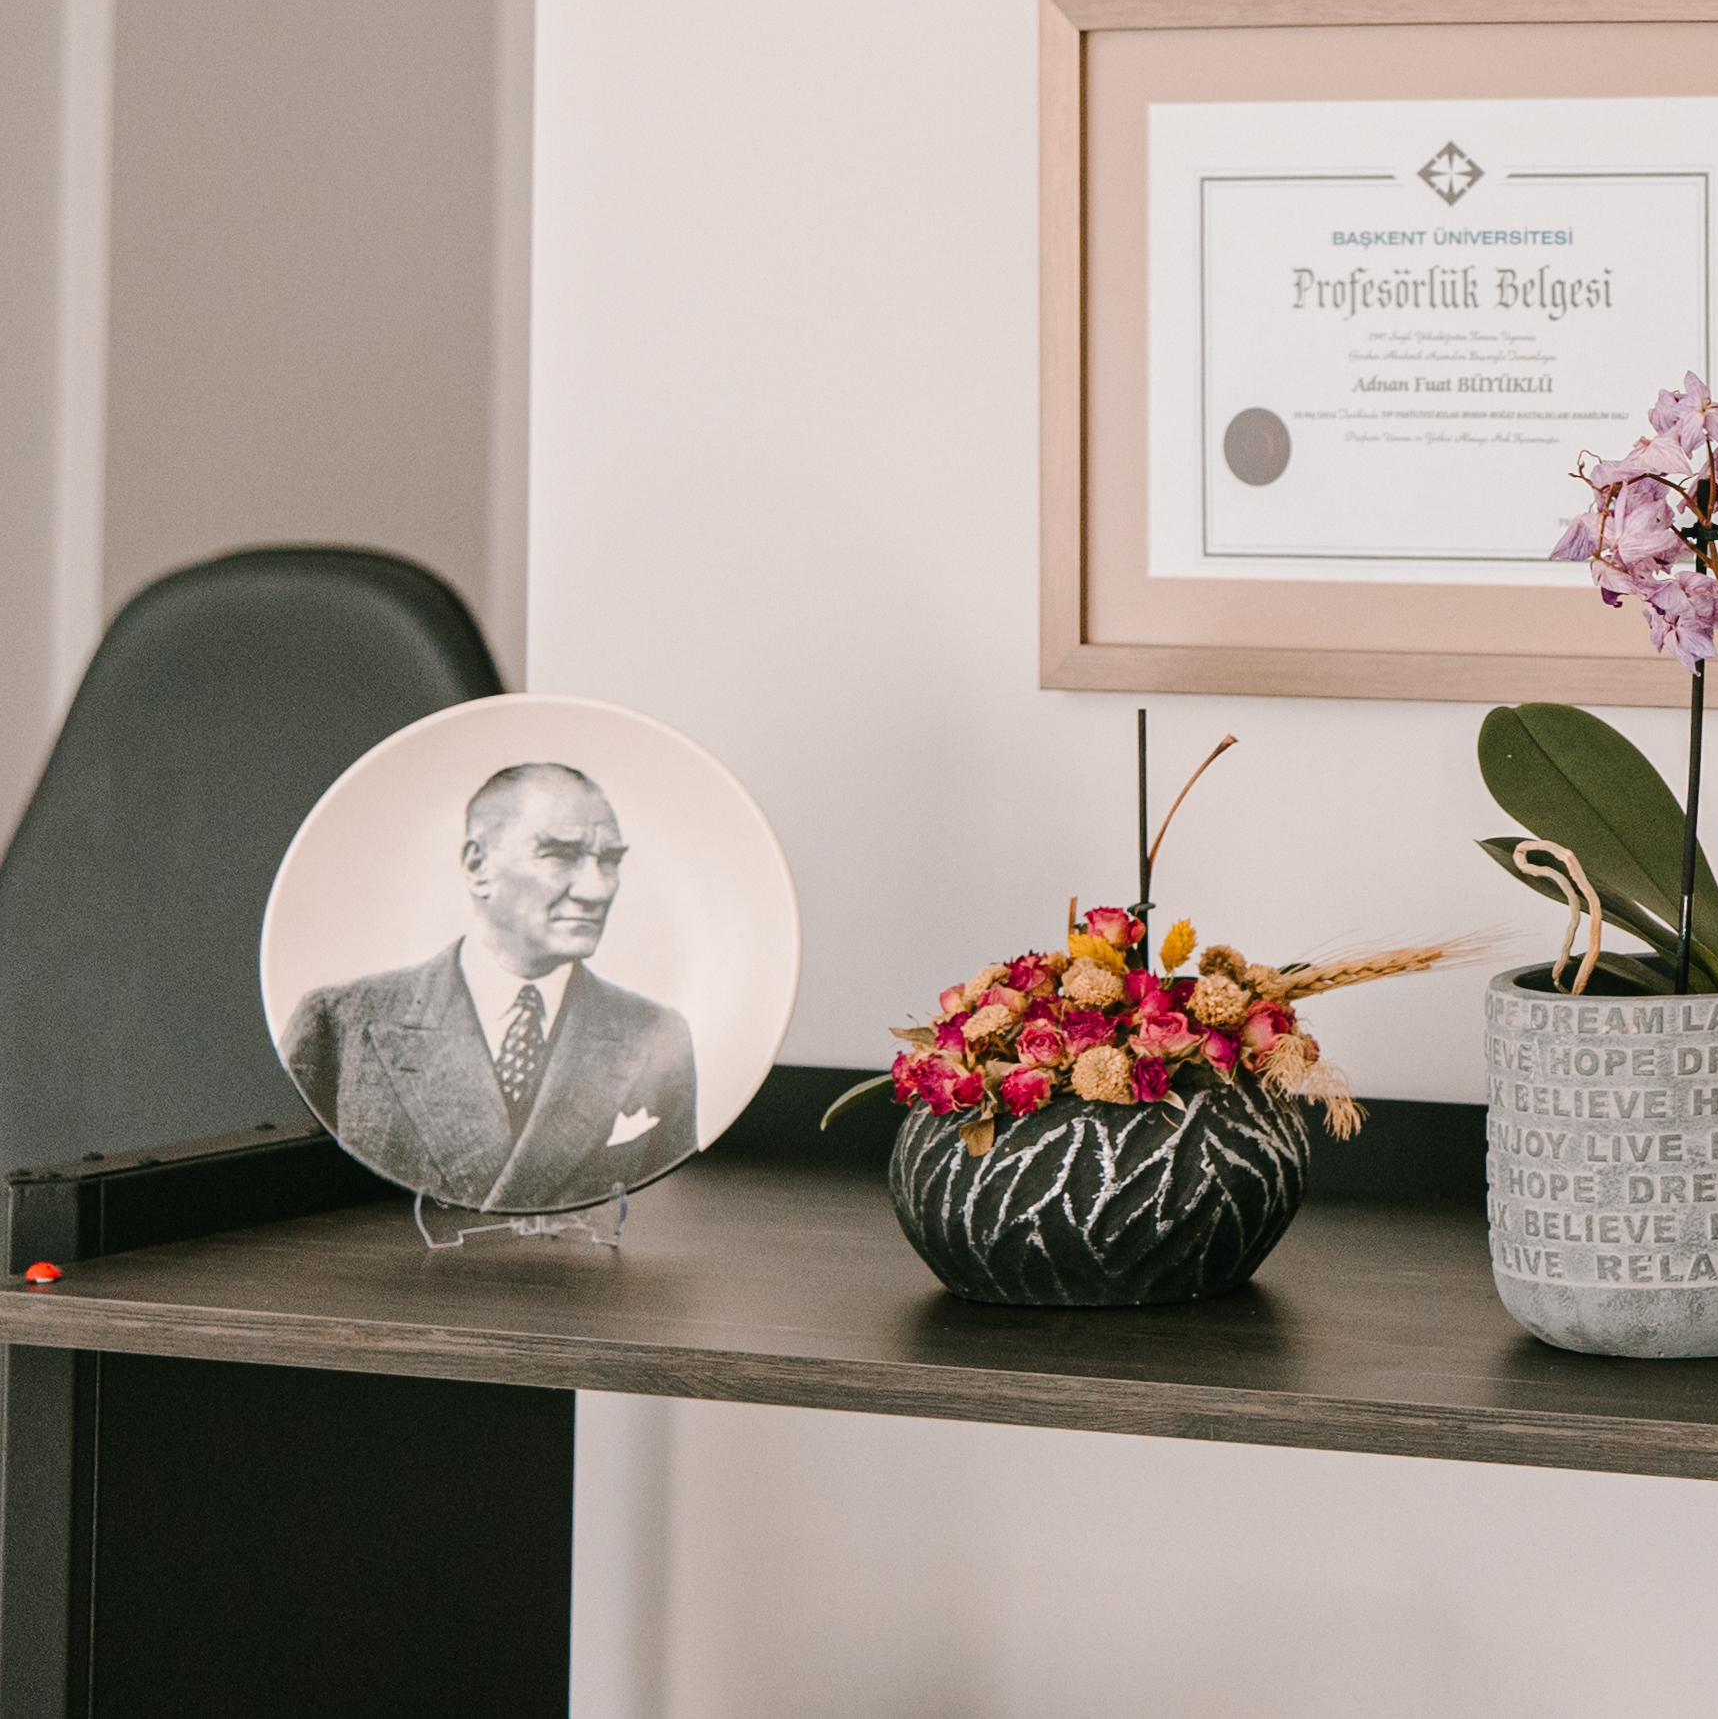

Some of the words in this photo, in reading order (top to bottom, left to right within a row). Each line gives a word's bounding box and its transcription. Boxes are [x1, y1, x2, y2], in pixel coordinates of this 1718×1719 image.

[1333, 231, 1426, 248] BAŞKENT
[1434, 226, 1574, 246] ÜNİVERSİTESİ
[1293, 265, 1479, 320] Profesörlük
[1496, 265, 1612, 321] Belgesi
[1352, 376, 1409, 392] Adnan
[1415, 377, 1452, 392] Fuat
[1457, 374, 1552, 393] BÜYÜKLÜ
[1530, 1003, 1663, 1033] DREAM
[1550, 1048, 1654, 1076] HOPE
[1515, 1084, 1667, 1118] BELIEVE
[1587, 1135, 1682, 1162] LIVE
[1510, 1168, 1595, 1203] HOPE
[1525, 1209, 1675, 1243] BELIEVE
[1502, 1242, 1564, 1278] LIVE
